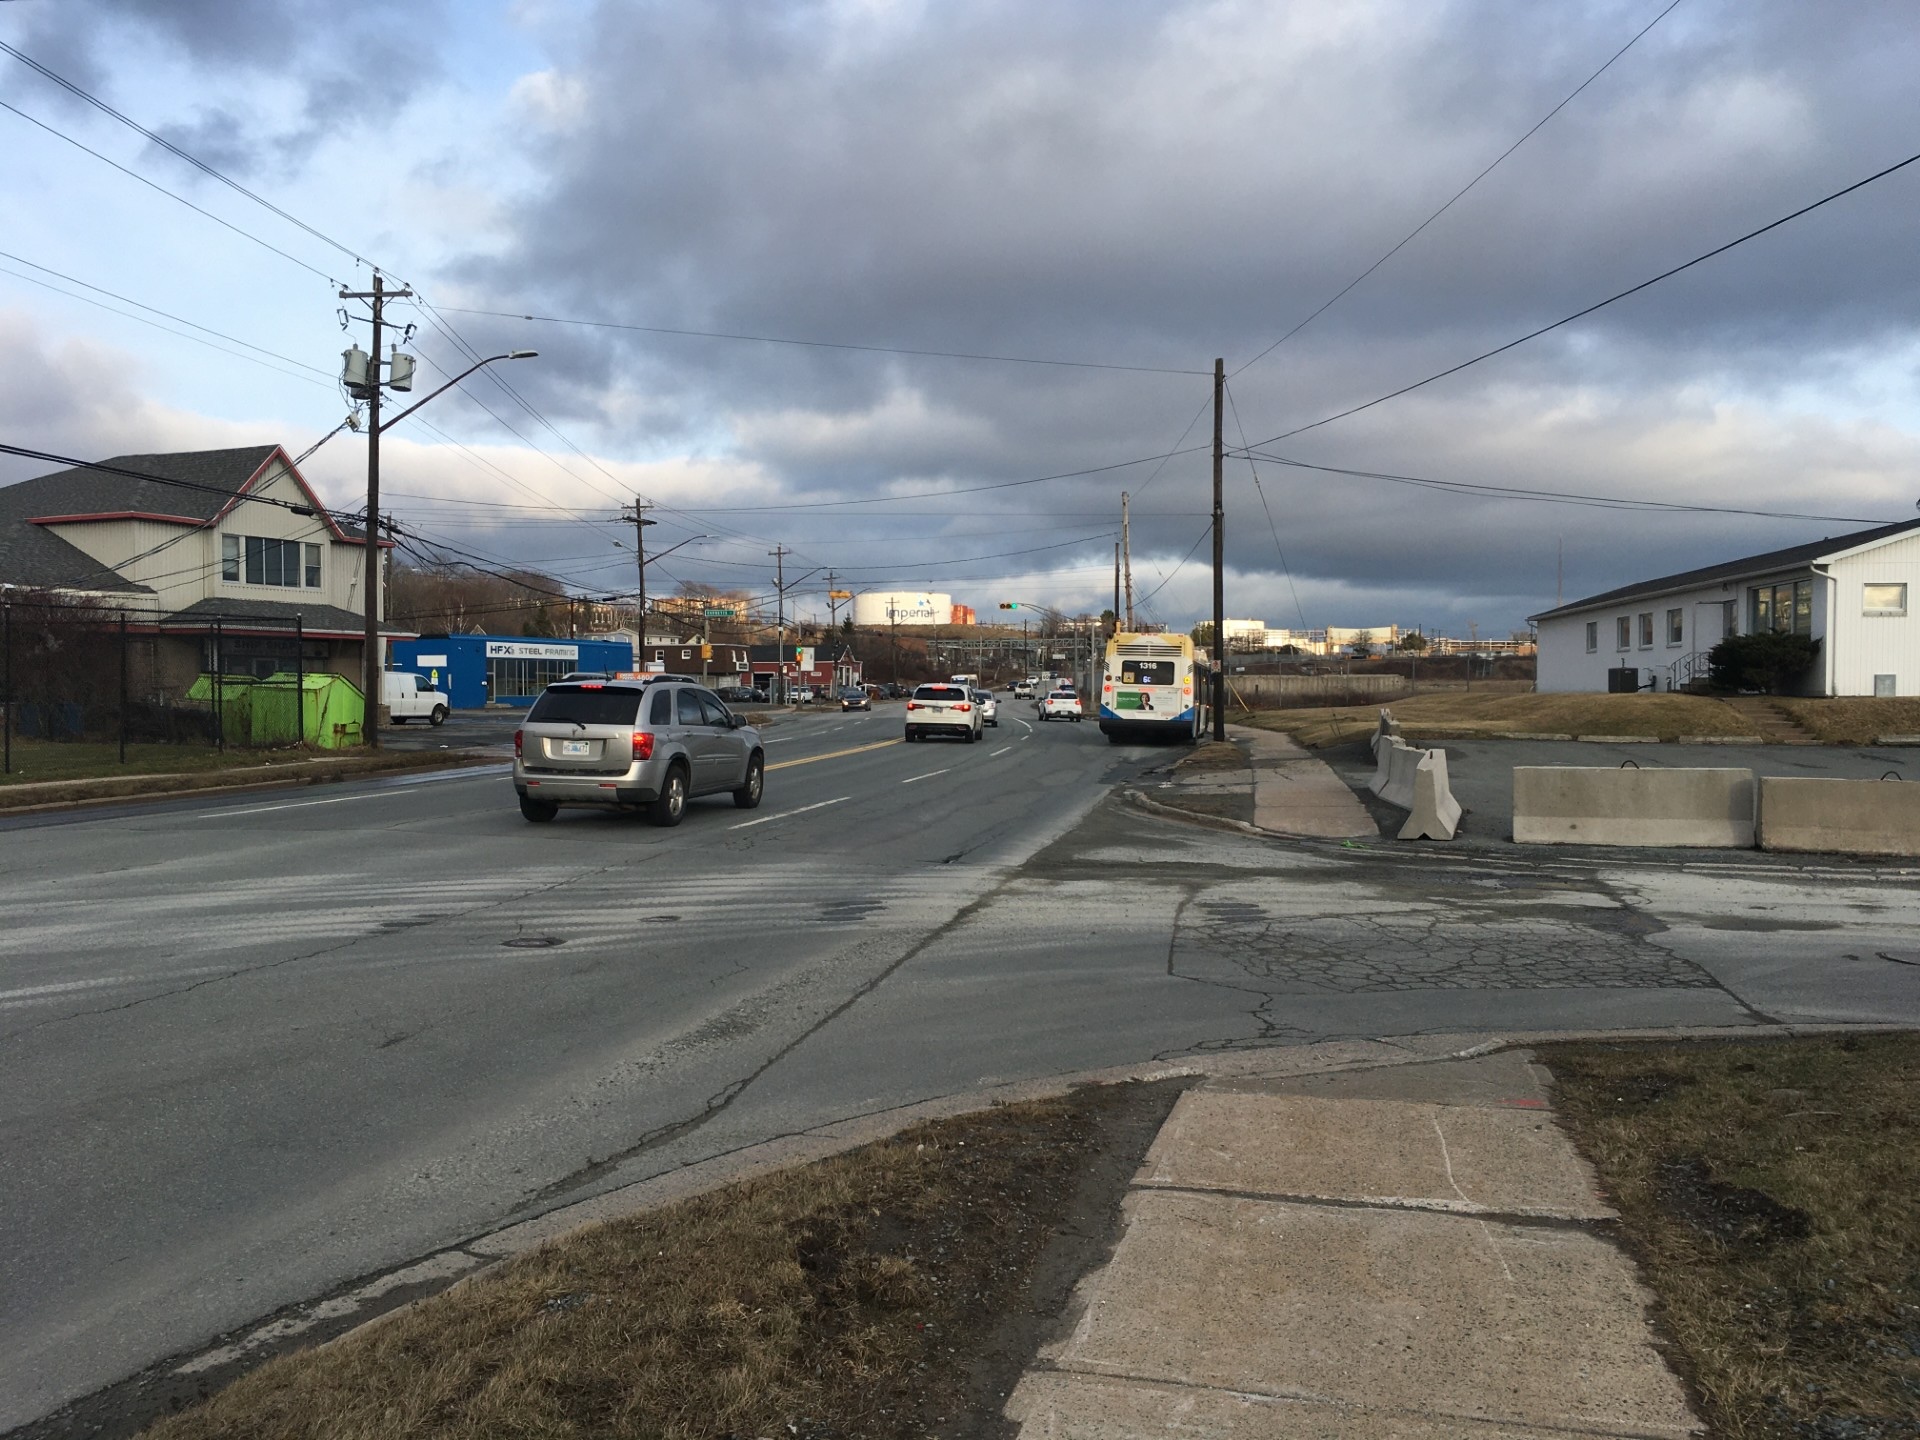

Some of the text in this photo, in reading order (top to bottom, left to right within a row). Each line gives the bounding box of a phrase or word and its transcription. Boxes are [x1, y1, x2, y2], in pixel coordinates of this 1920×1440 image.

[886, 606, 933, 620] Imperial
[266, 640, 300, 650] SHAP
[519, 647, 543, 655] STEEL
[544, 648, 576, 656] FRAMING
